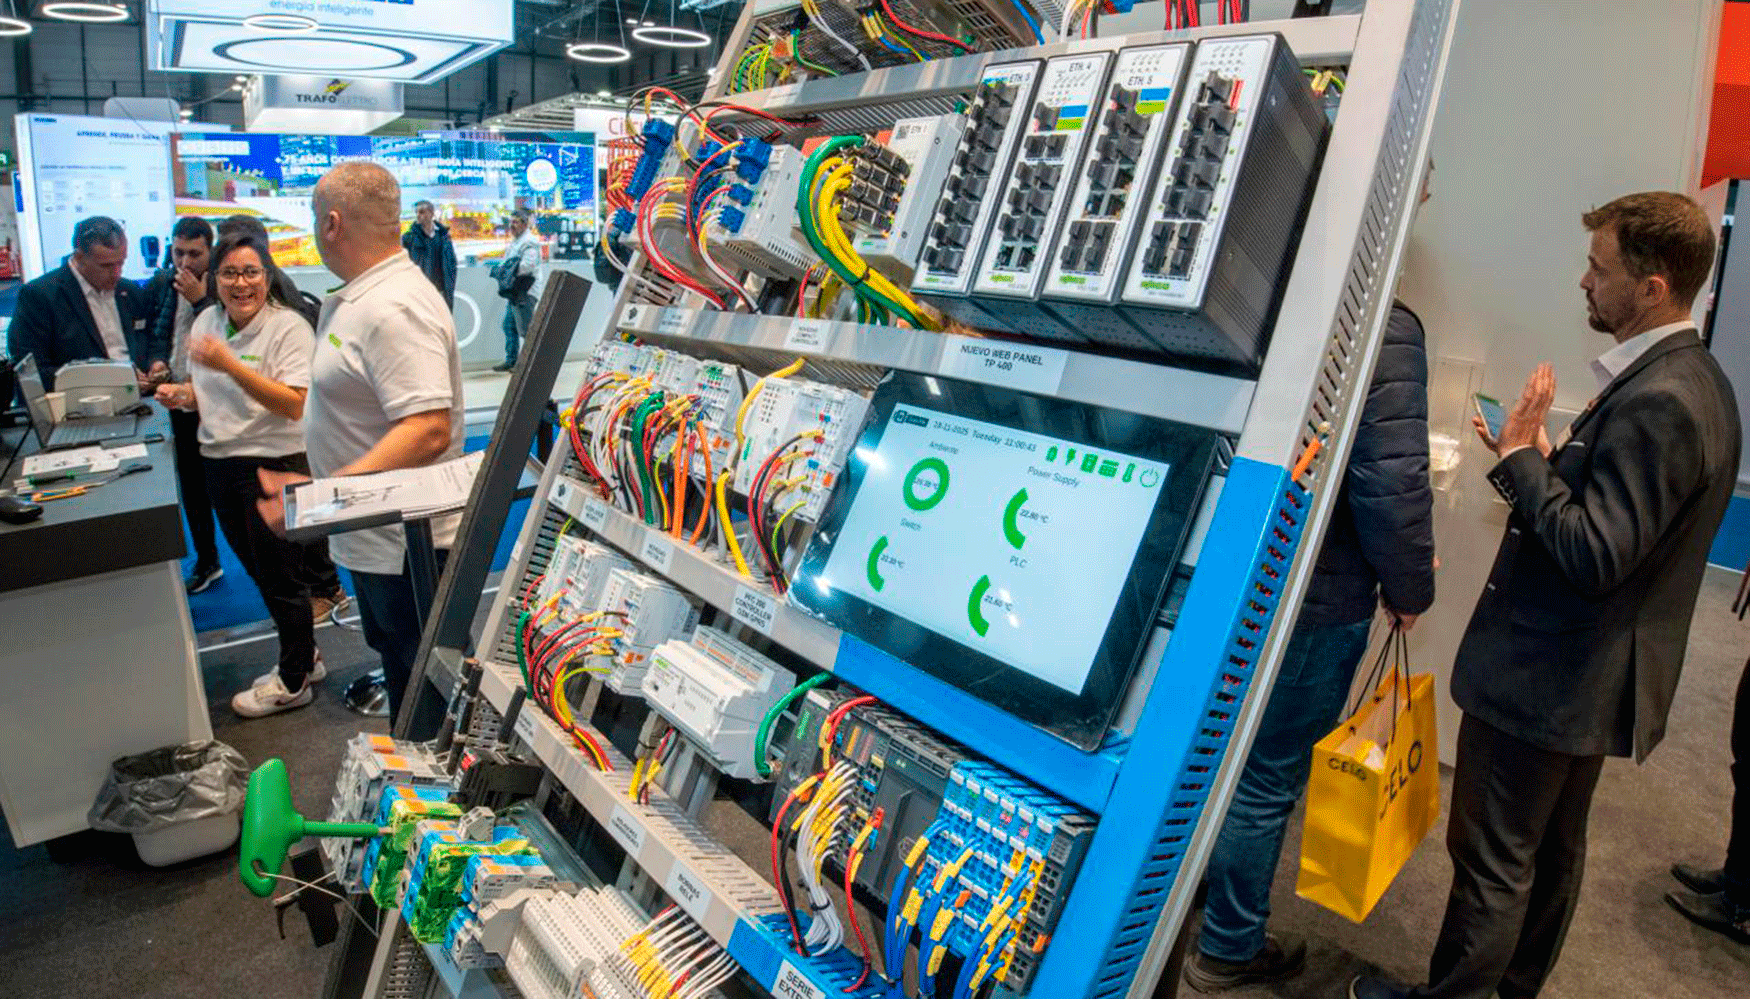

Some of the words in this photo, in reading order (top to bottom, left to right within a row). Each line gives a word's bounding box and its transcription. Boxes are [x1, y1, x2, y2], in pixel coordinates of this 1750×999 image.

[317, 3, 374, 16] inteligente
[1069, 63, 1084, 72] ETH
[1086, 62, 1092, 70] 4
[1128, 76, 1143, 86] ETH
[960, 345, 991, 357] NUEVO
[992, 349, 1012, 361] WEB
[1012, 352, 1044, 366] PANEL
[985, 358, 996, 367] TP
[973, 429, 1002, 445] Tuesday
[1027, 466, 1052, 478] Power
[1053, 472, 1081, 488] Supply
[900, 517, 922, 531] Switch
[1009, 554, 1028, 569] PLC
[735, 597, 772, 621] CONTROLLER
[1328, 757, 1367, 782] CELO
[786, 970, 815, 999] SERIE
